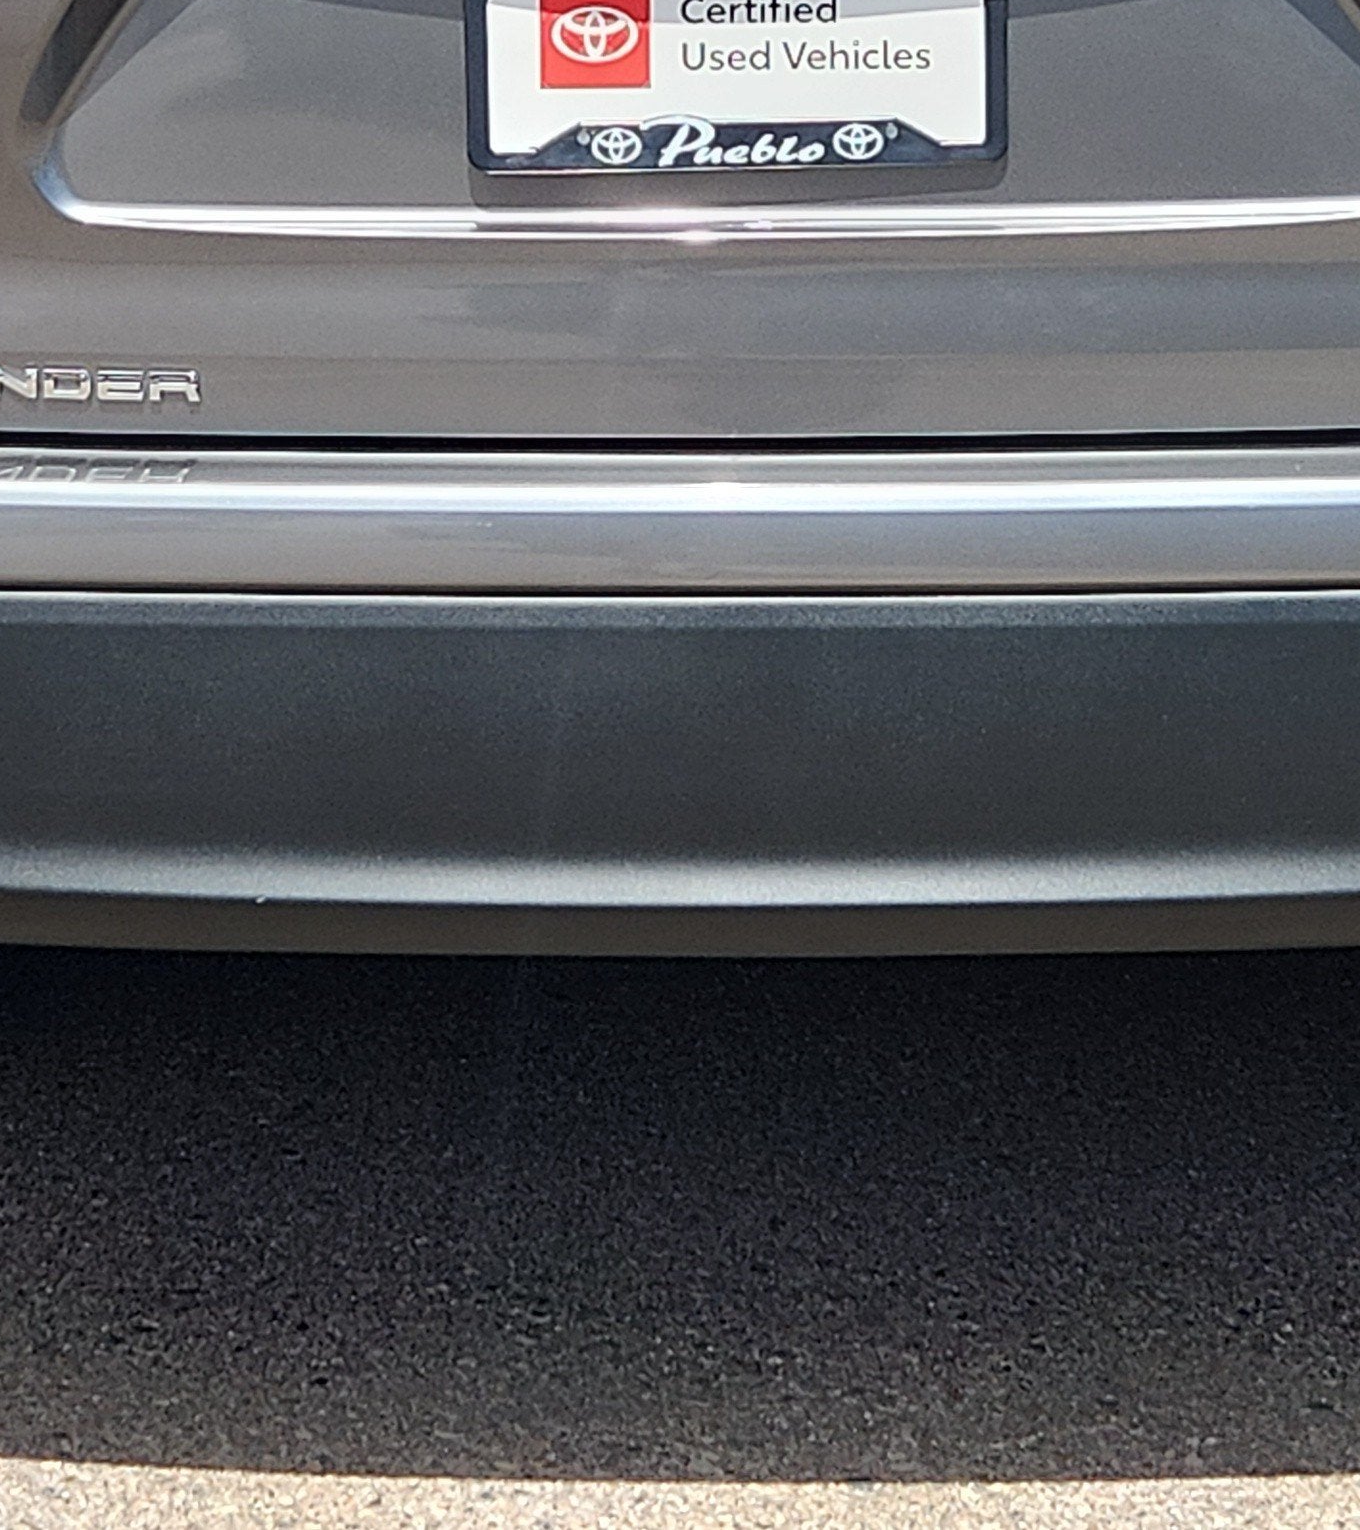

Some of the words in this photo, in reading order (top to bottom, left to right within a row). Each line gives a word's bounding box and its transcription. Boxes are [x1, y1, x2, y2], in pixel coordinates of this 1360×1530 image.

[681, 41, 771, 70] Used
[782, 40, 932, 70] Vehicles
[643, 115, 827, 167] Pueblo
